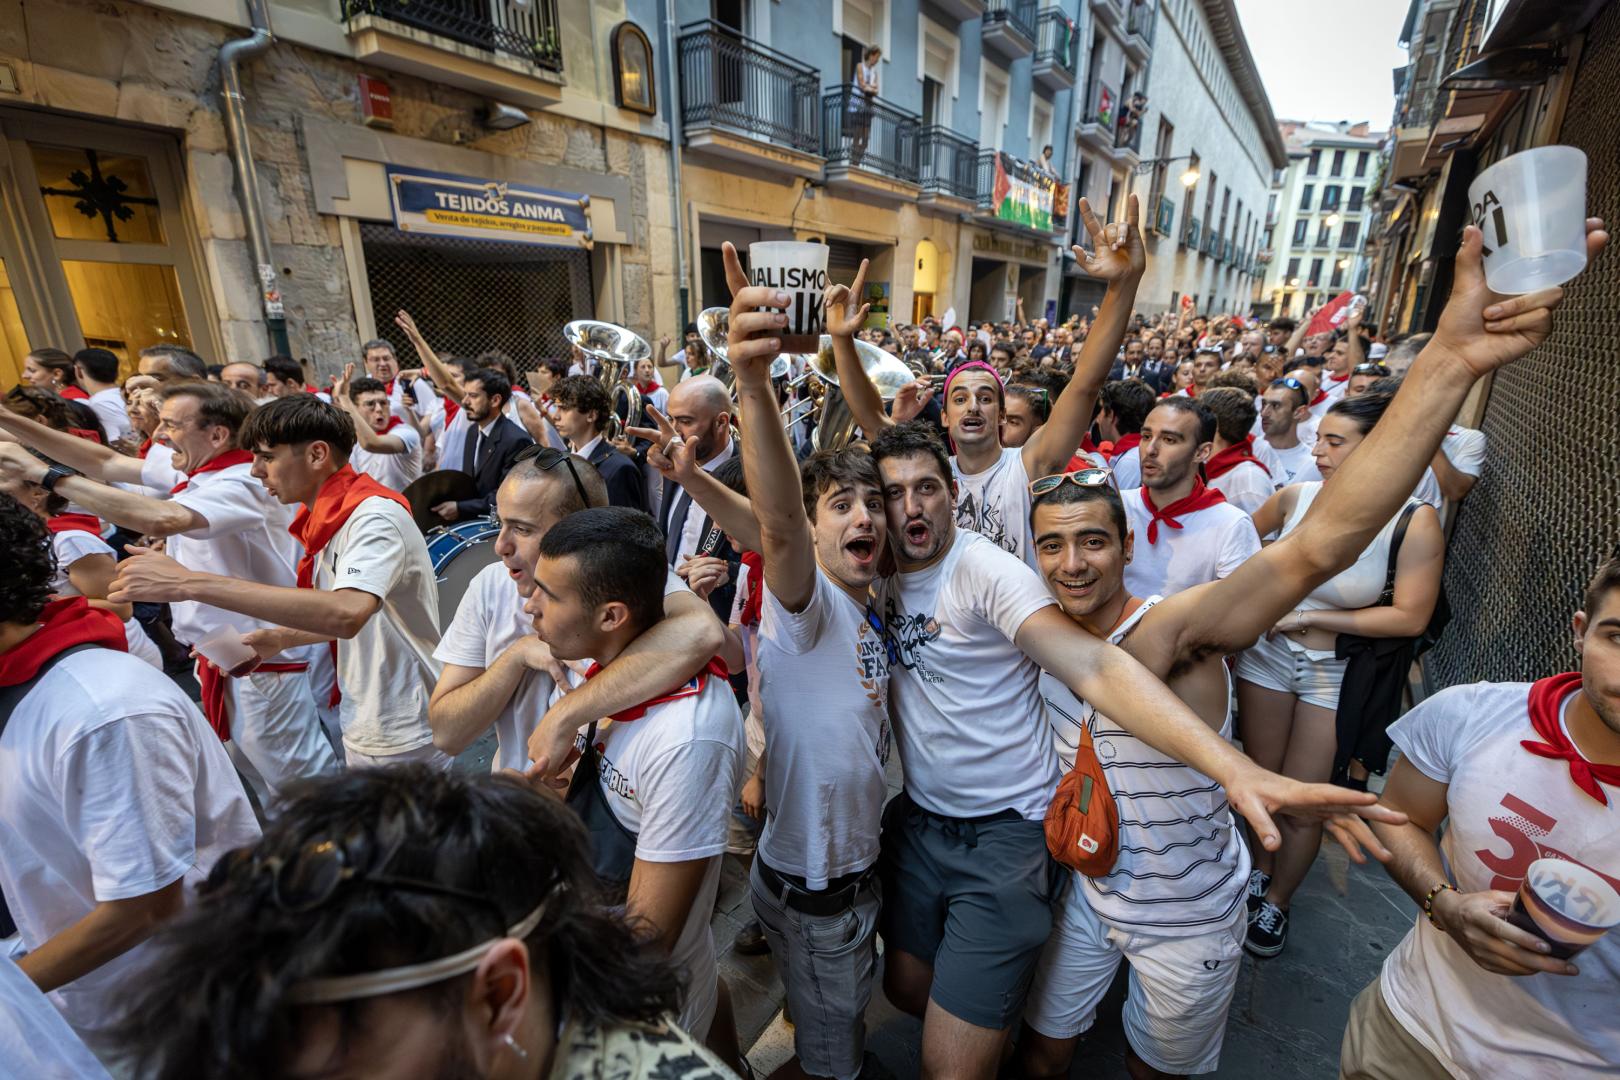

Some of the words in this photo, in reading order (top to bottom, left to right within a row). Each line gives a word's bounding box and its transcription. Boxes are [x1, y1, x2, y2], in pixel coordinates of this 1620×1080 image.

[435, 192, 510, 216] TEJIDOS
[512, 202, 566, 222] ANMA
[434, 212, 460, 223] Venta
[461, 215, 471, 223] de
